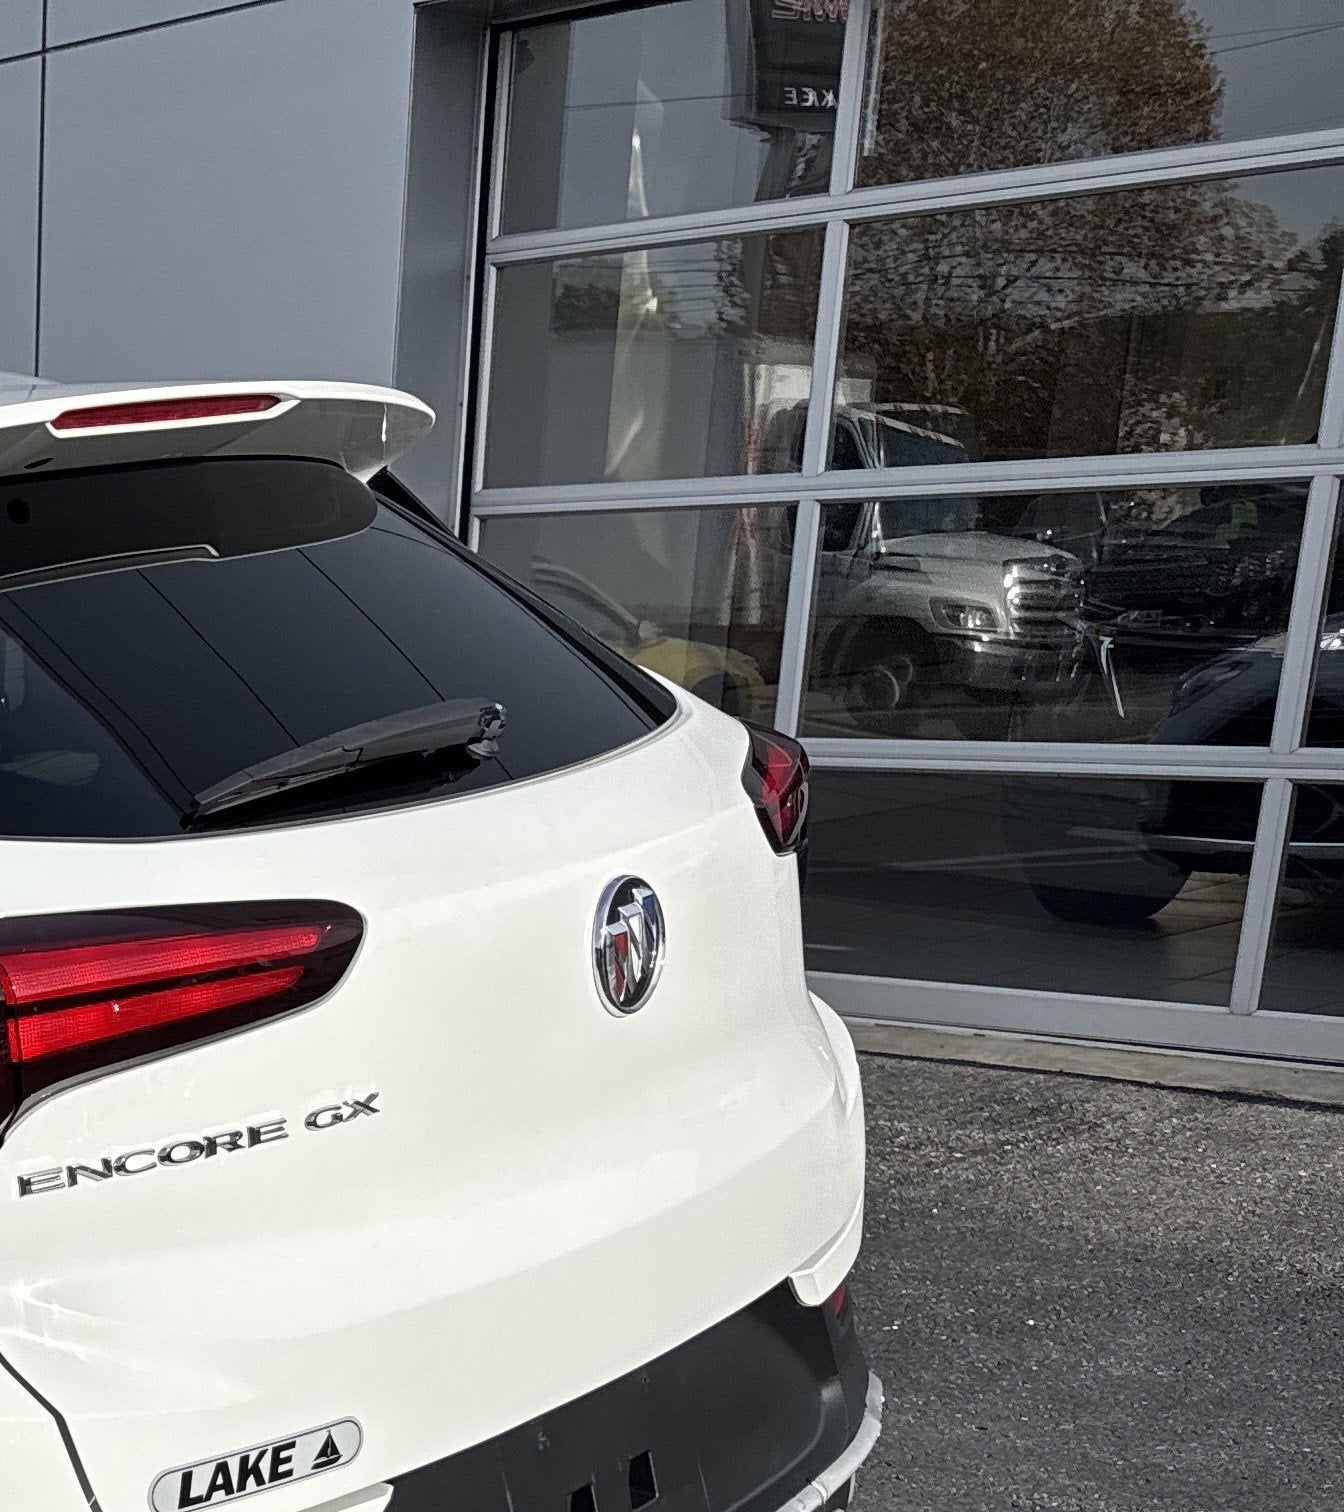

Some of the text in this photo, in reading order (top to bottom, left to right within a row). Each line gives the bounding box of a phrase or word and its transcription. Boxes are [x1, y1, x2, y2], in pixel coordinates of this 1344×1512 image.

[18, 1092, 380, 1197] ENCORE GX
[178, 1440, 296, 1509] LAKE
